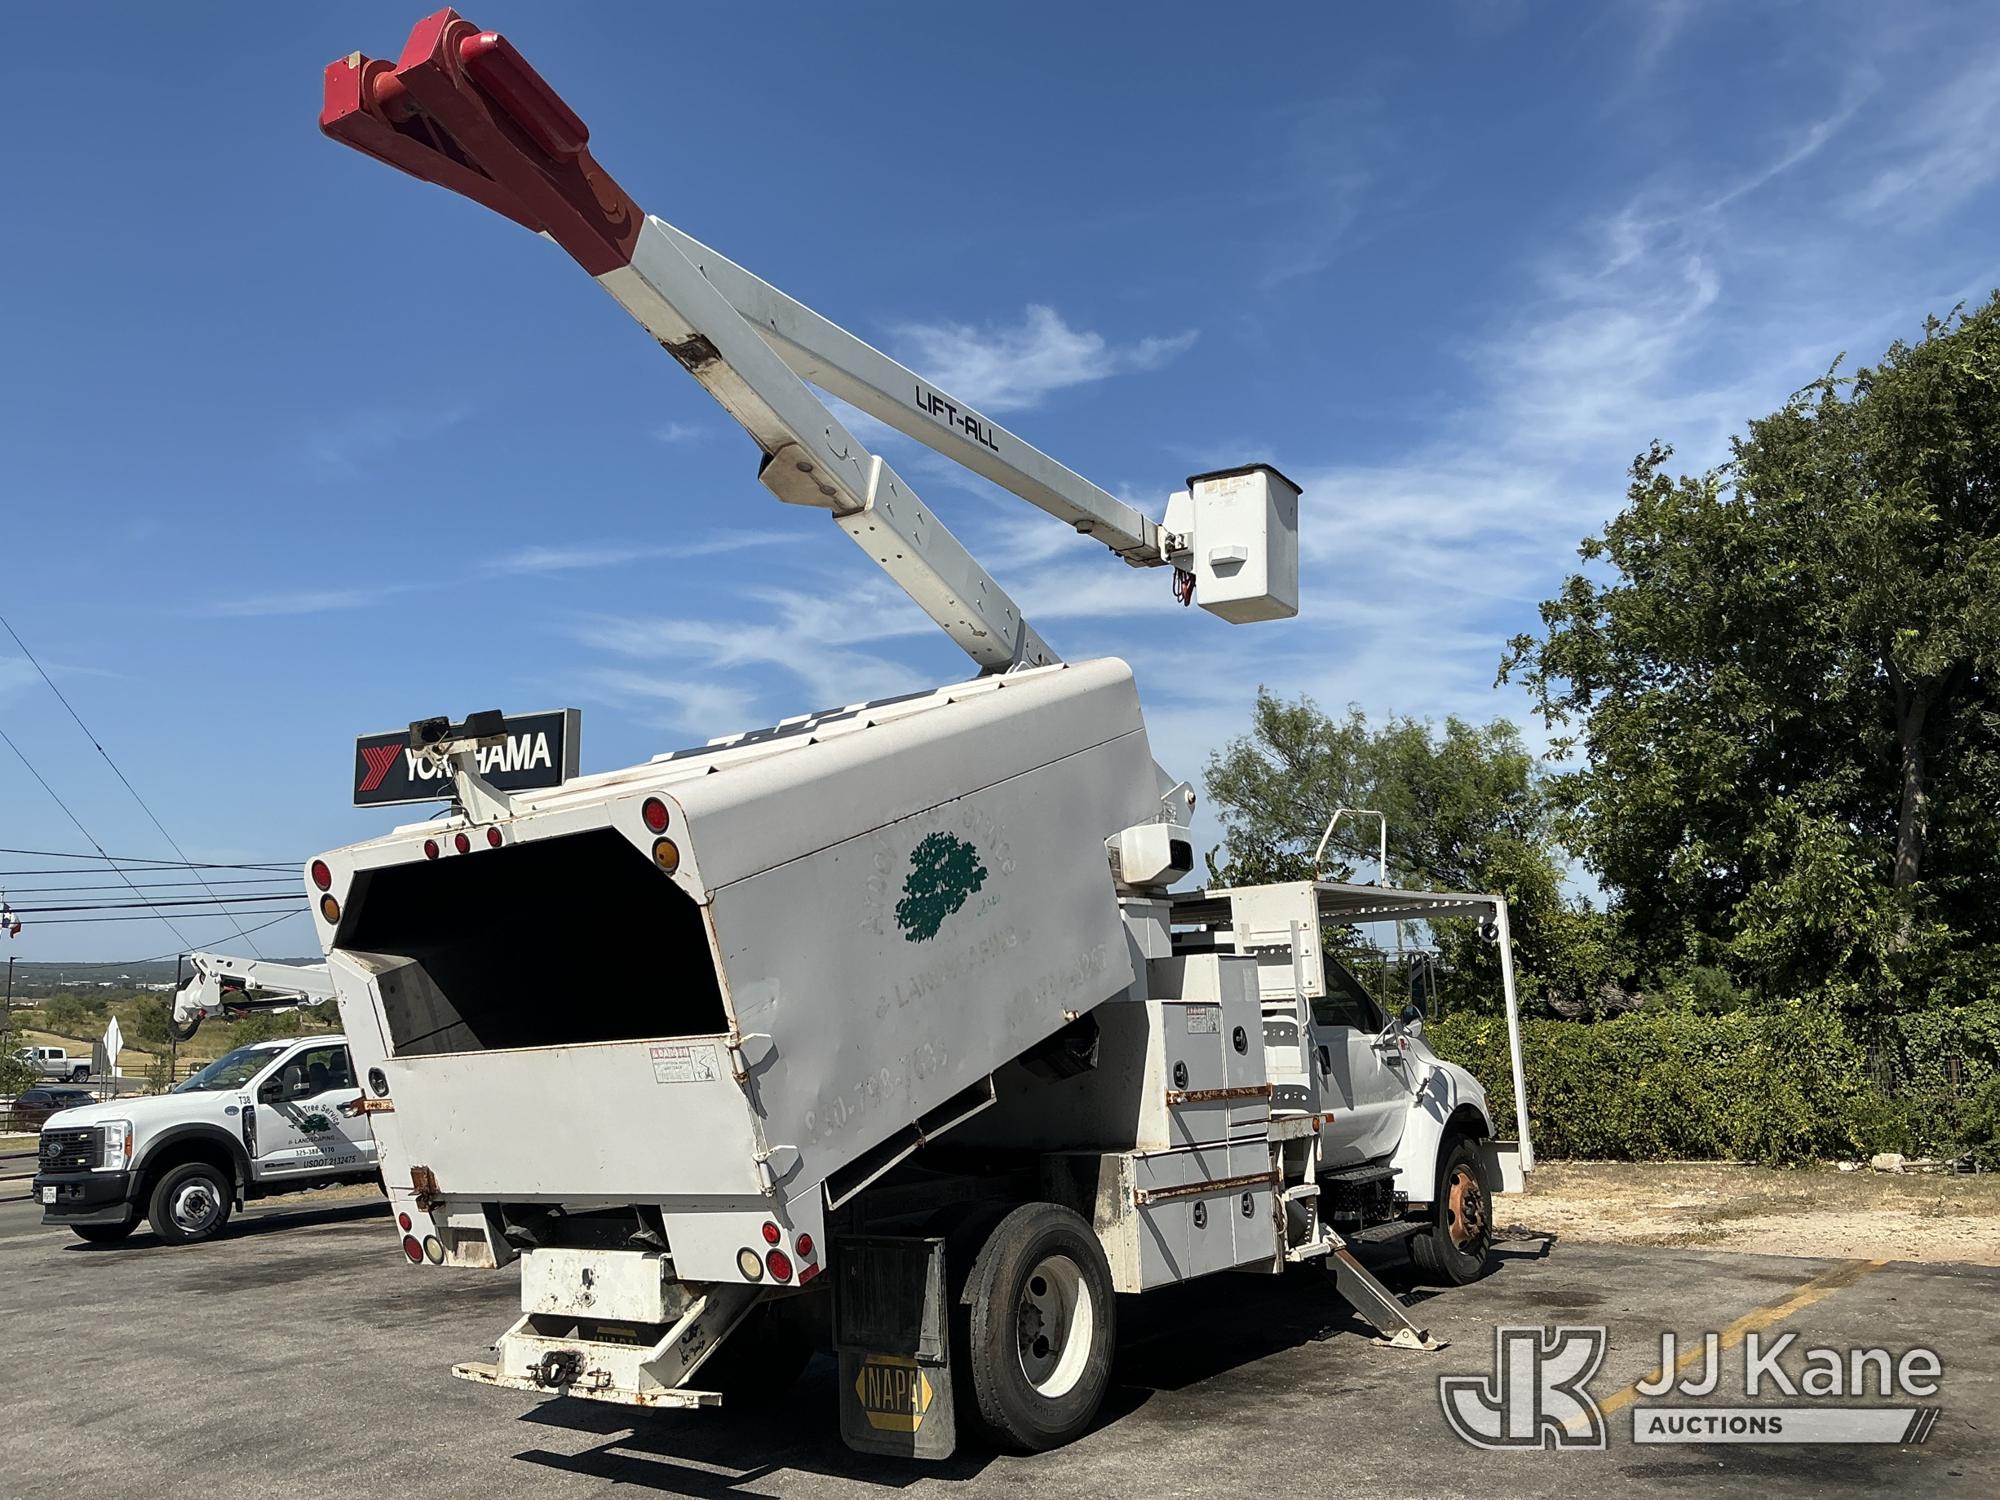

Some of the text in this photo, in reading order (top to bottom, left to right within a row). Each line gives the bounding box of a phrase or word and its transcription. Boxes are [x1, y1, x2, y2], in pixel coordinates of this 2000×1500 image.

[915, 385, 999, 452] LIFT-ALL
[404, 731, 553, 781] YOKHAMA
[238, 1096, 251, 1104] T38
[302, 1104, 319, 1113] Tree
[320, 1104, 341, 1126] Service
[294, 1135, 335, 1145] LANDSCAPING
[303, 1158, 329, 1169] USDOT
[329, 1155, 357, 1165] 2132475
[868, 1367, 920, 1413] NAPA
